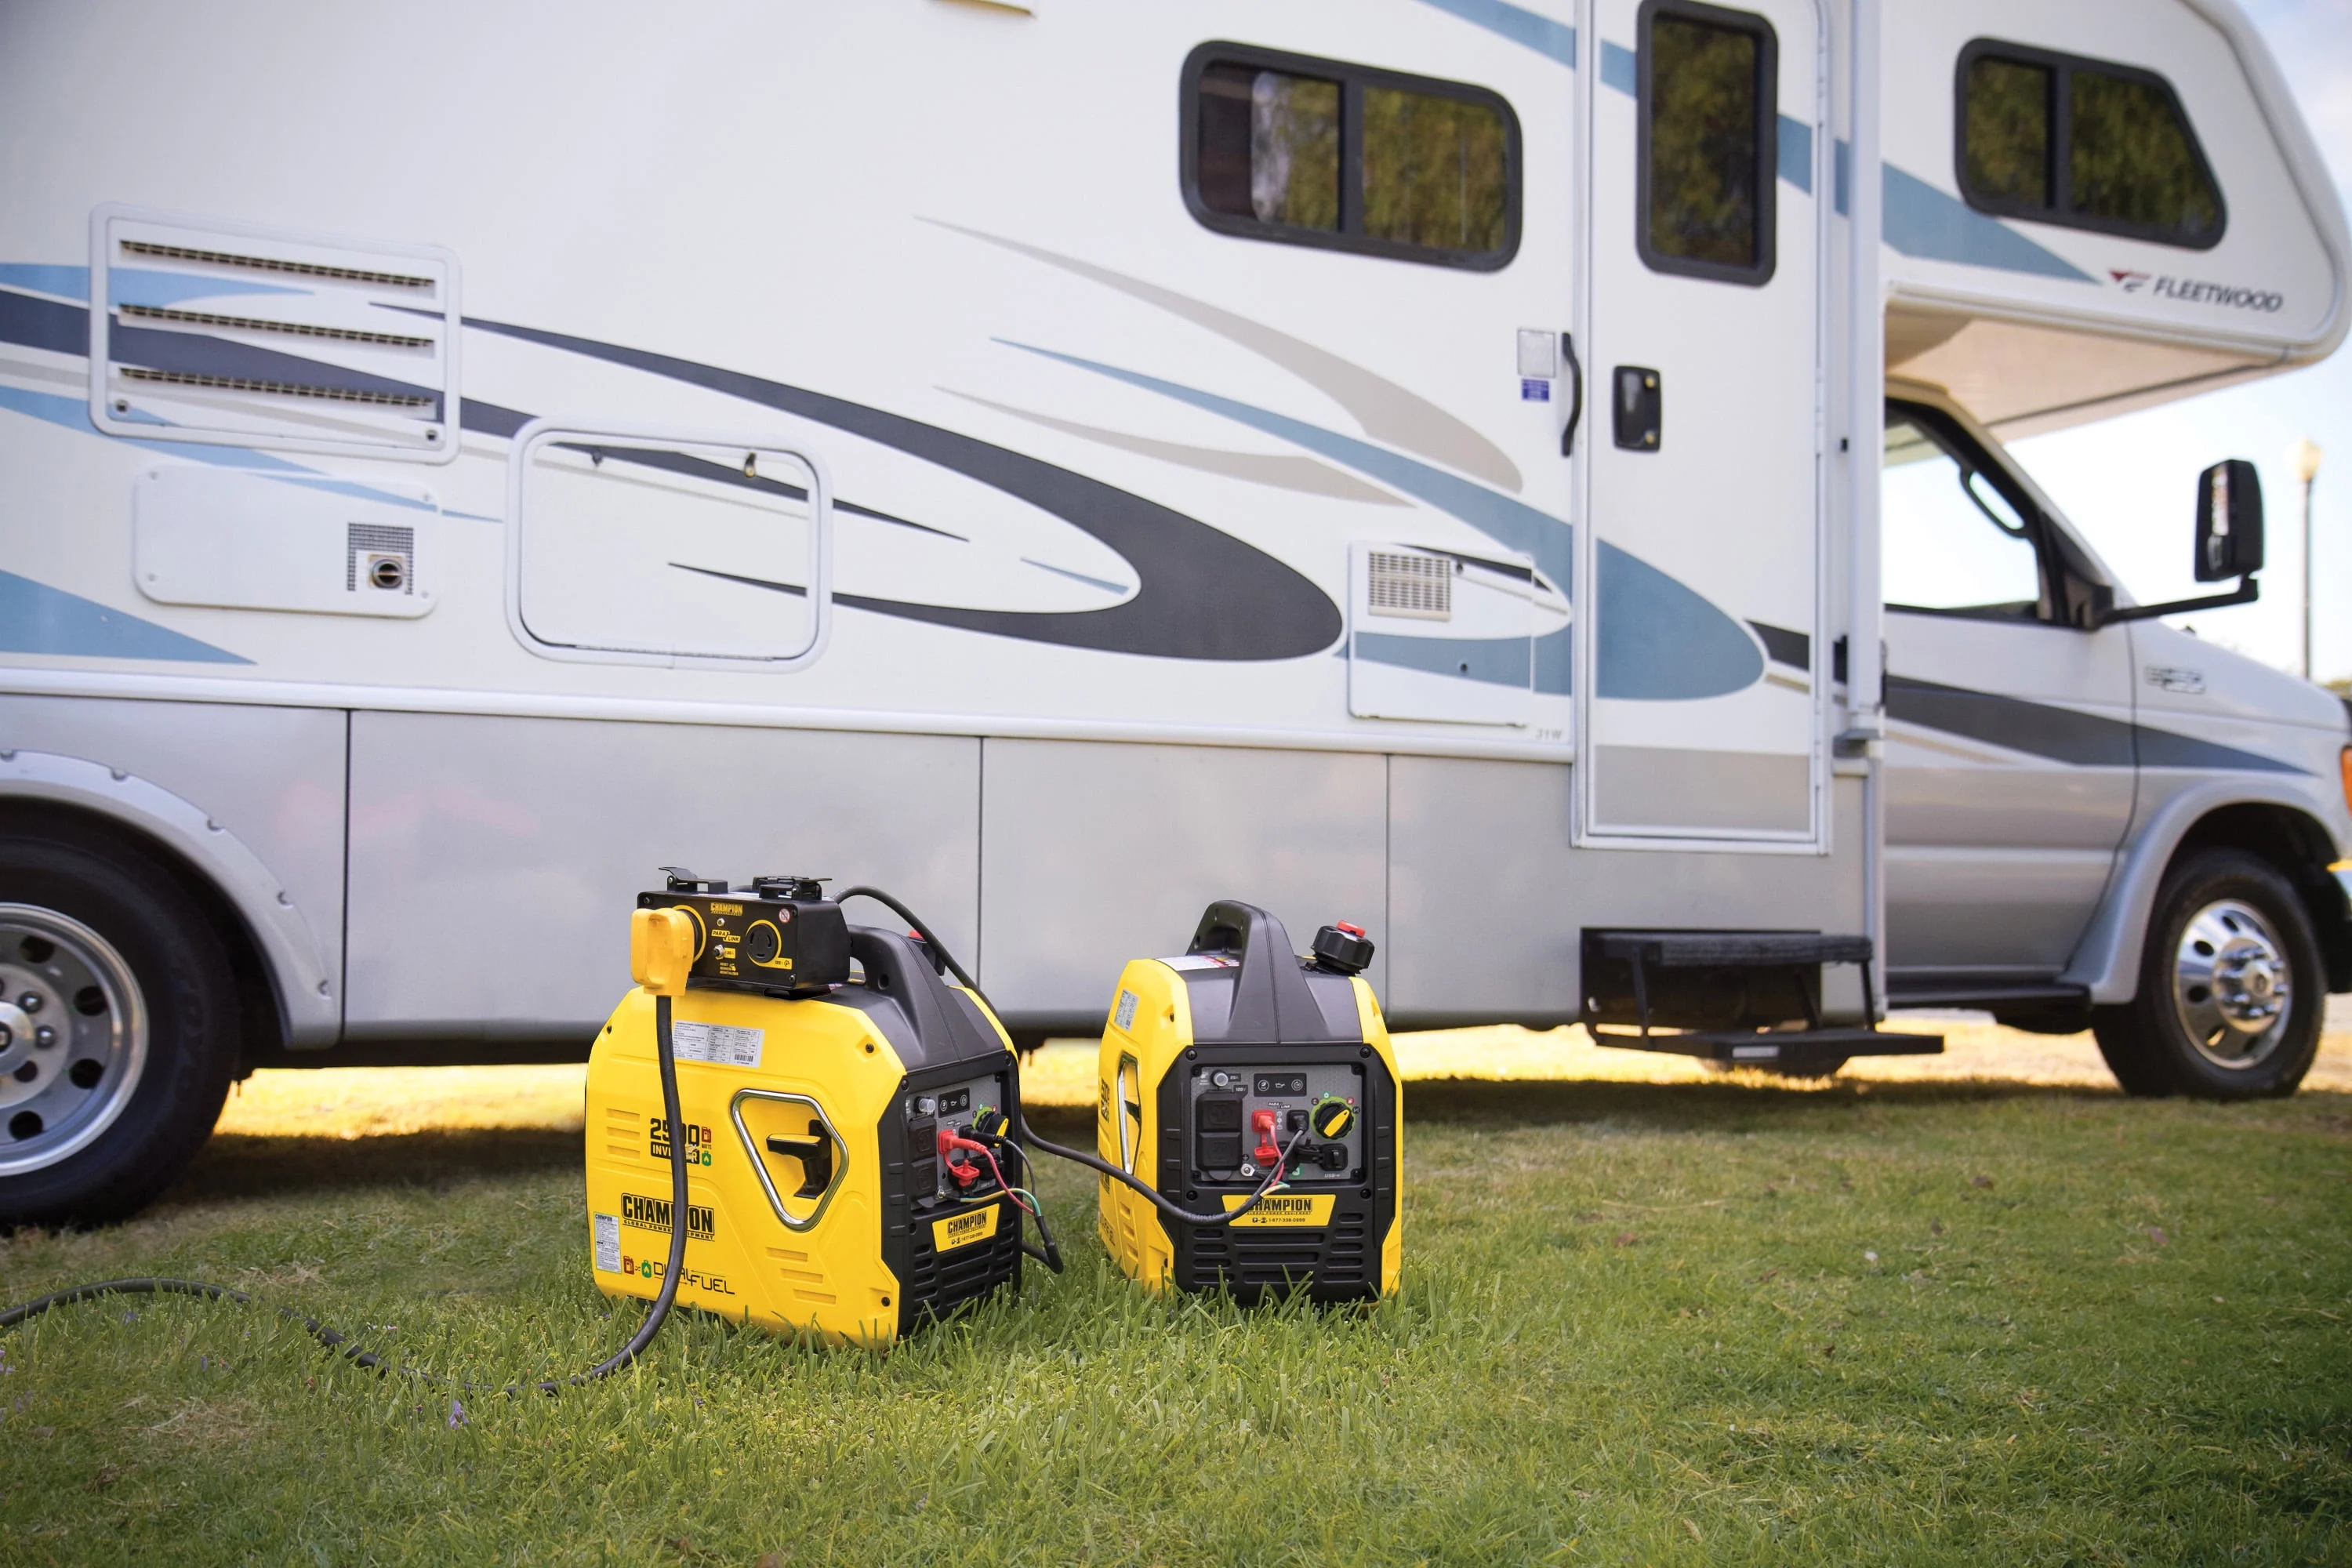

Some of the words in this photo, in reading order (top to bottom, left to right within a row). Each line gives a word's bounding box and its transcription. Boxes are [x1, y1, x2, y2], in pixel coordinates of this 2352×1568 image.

[2154, 276, 2285, 313] FLEETWOOD
[710, 902, 743, 913] CHAMPION
[622, 1193, 714, 1235] CHAMON
[1249, 1199, 1312, 1211] HAMPION
[623, 1219, 648, 1228] GLOBAL
[648, 1222, 672, 1232] POWER
[948, 1211, 987, 1234] CHAMPION
